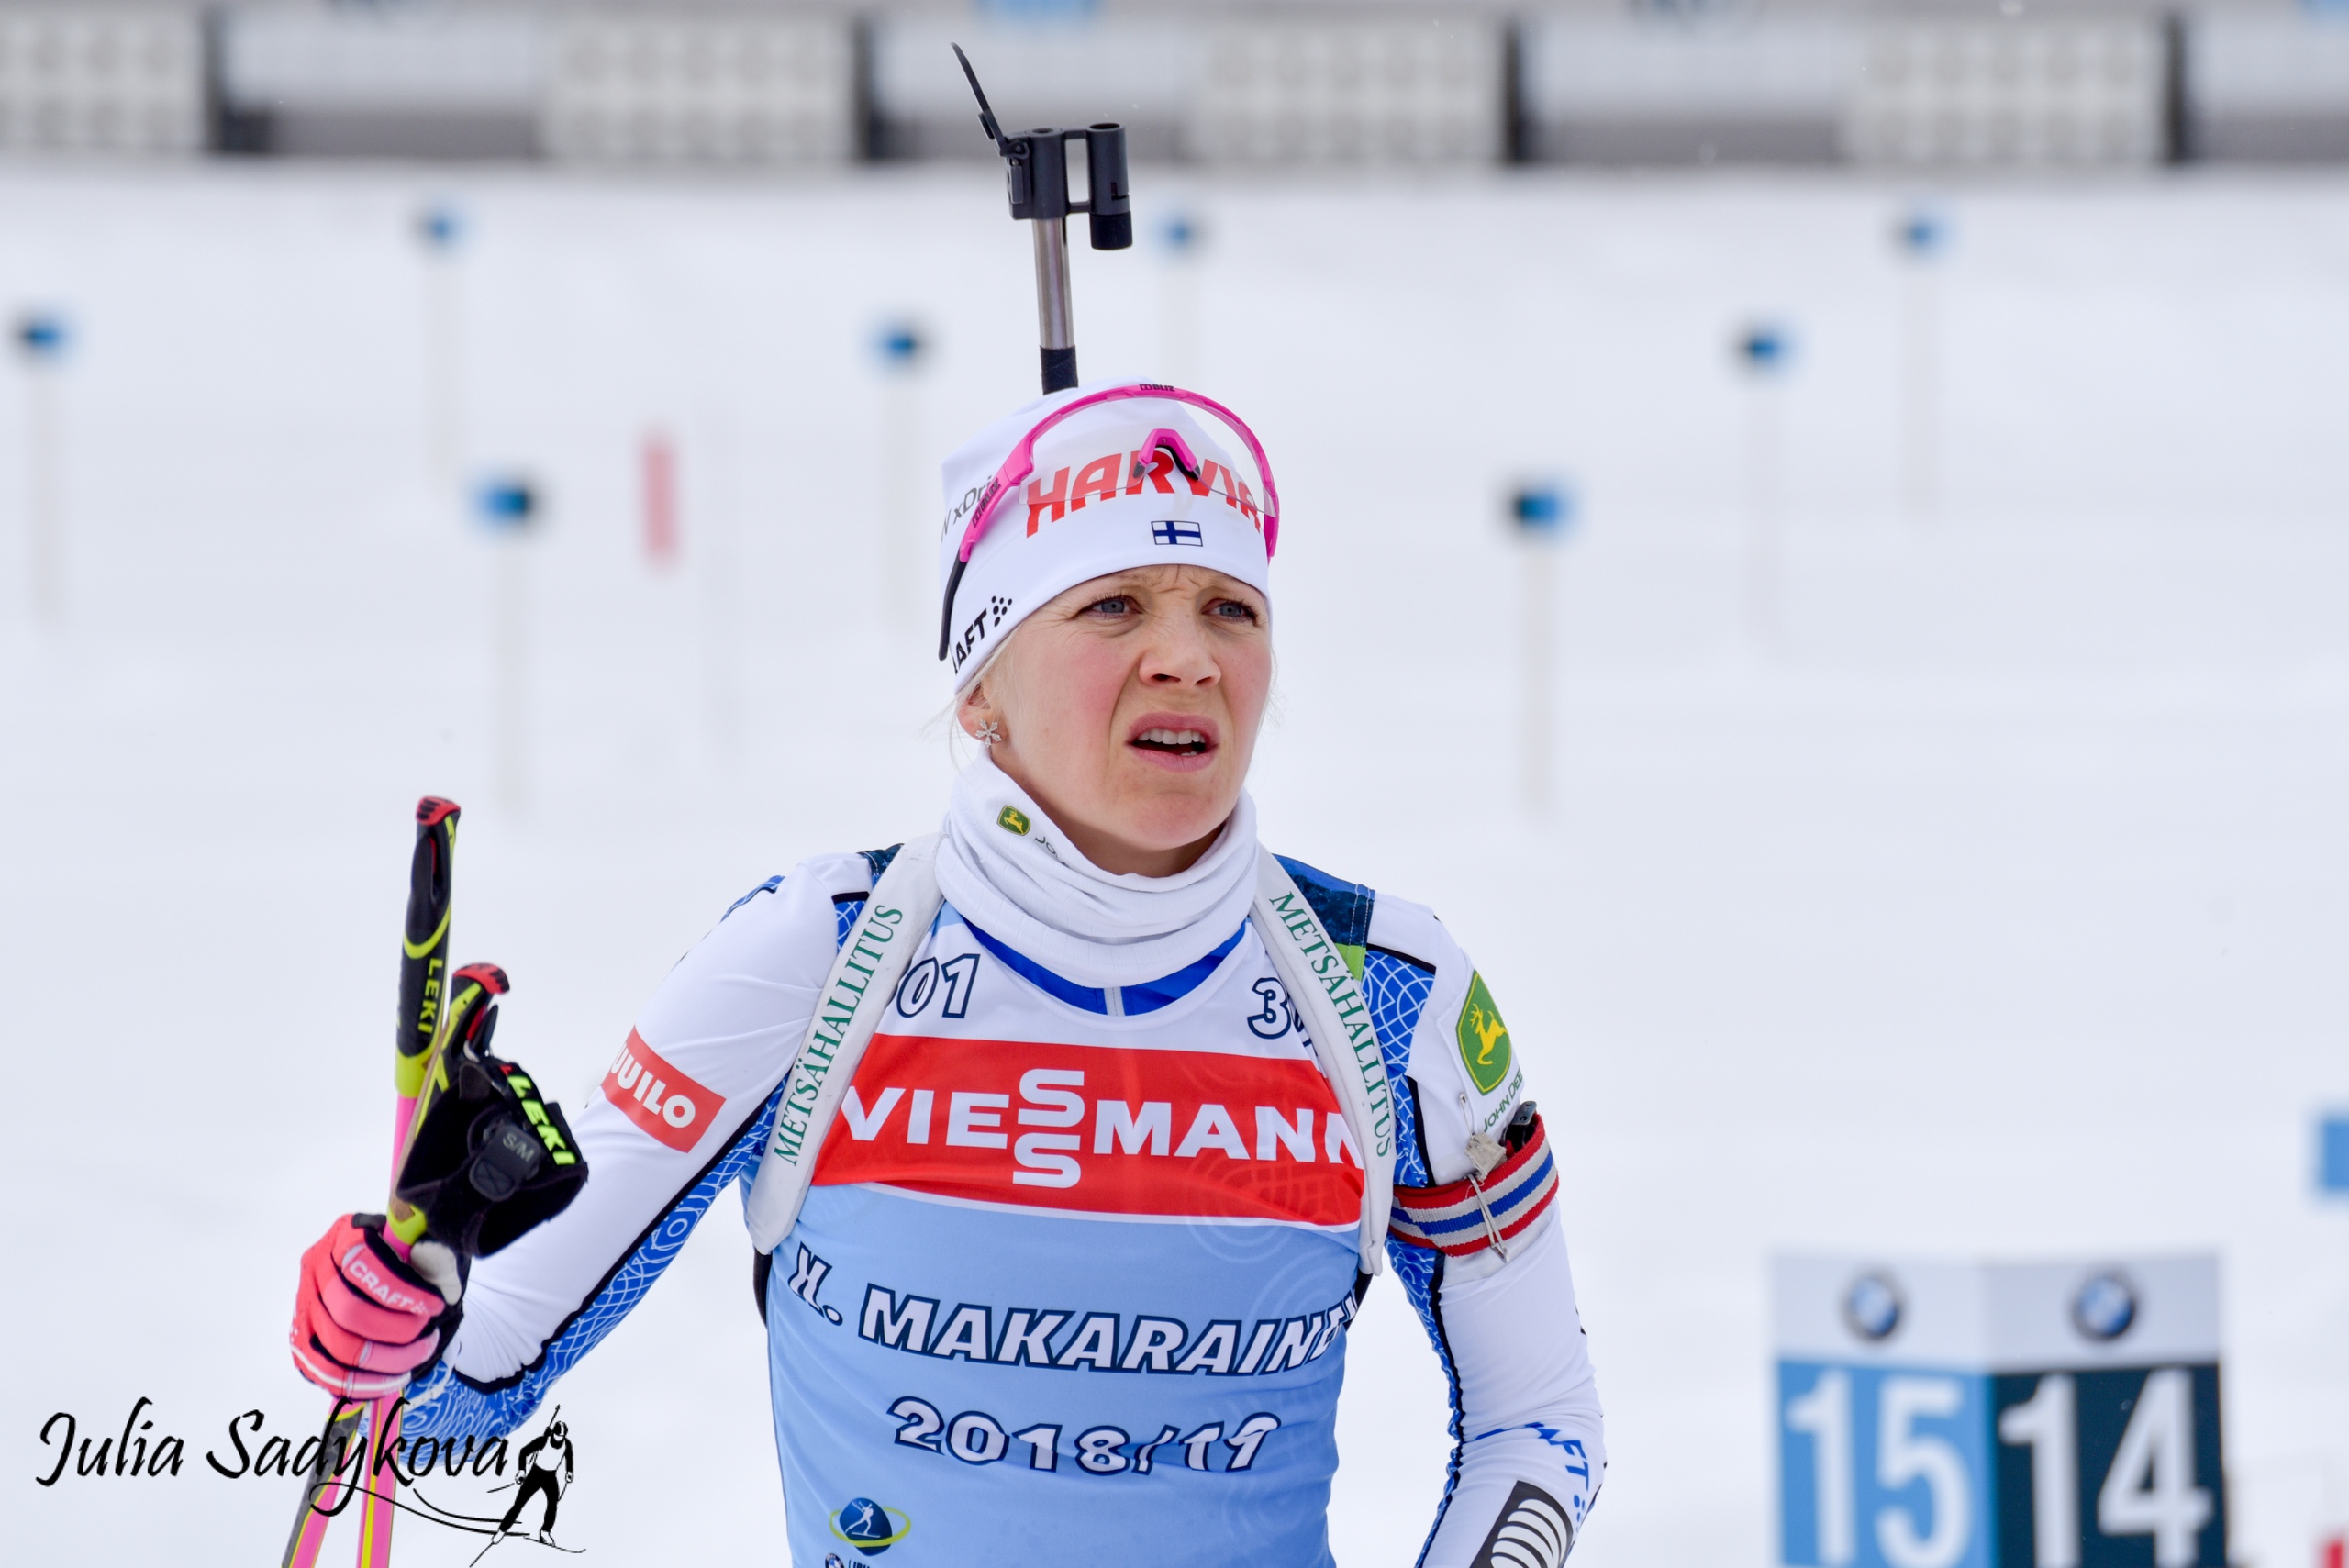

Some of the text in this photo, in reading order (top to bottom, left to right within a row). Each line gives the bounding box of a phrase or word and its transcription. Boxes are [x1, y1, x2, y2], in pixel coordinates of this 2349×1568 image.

[1026, 450, 1261, 539] HARVIA
[952, 607, 987, 675] AFT
[417, 957, 443, 1033] LEKI
[773, 904, 904, 1167] METSÄHALLITUS
[1268, 890, 1394, 1158] METSÄHALLITUS
[507, 1074, 576, 1165] LEKI
[1484, 1095, 1510, 1133] JOHN
[349, 1259, 414, 1309] CRAFT
[787, 1240, 843, 1327] K.
[886, 1395, 1282, 1475] 2018/19
[1783, 1369, 1975, 1568] 15
[1998, 1367, 2213, 1568] 14
